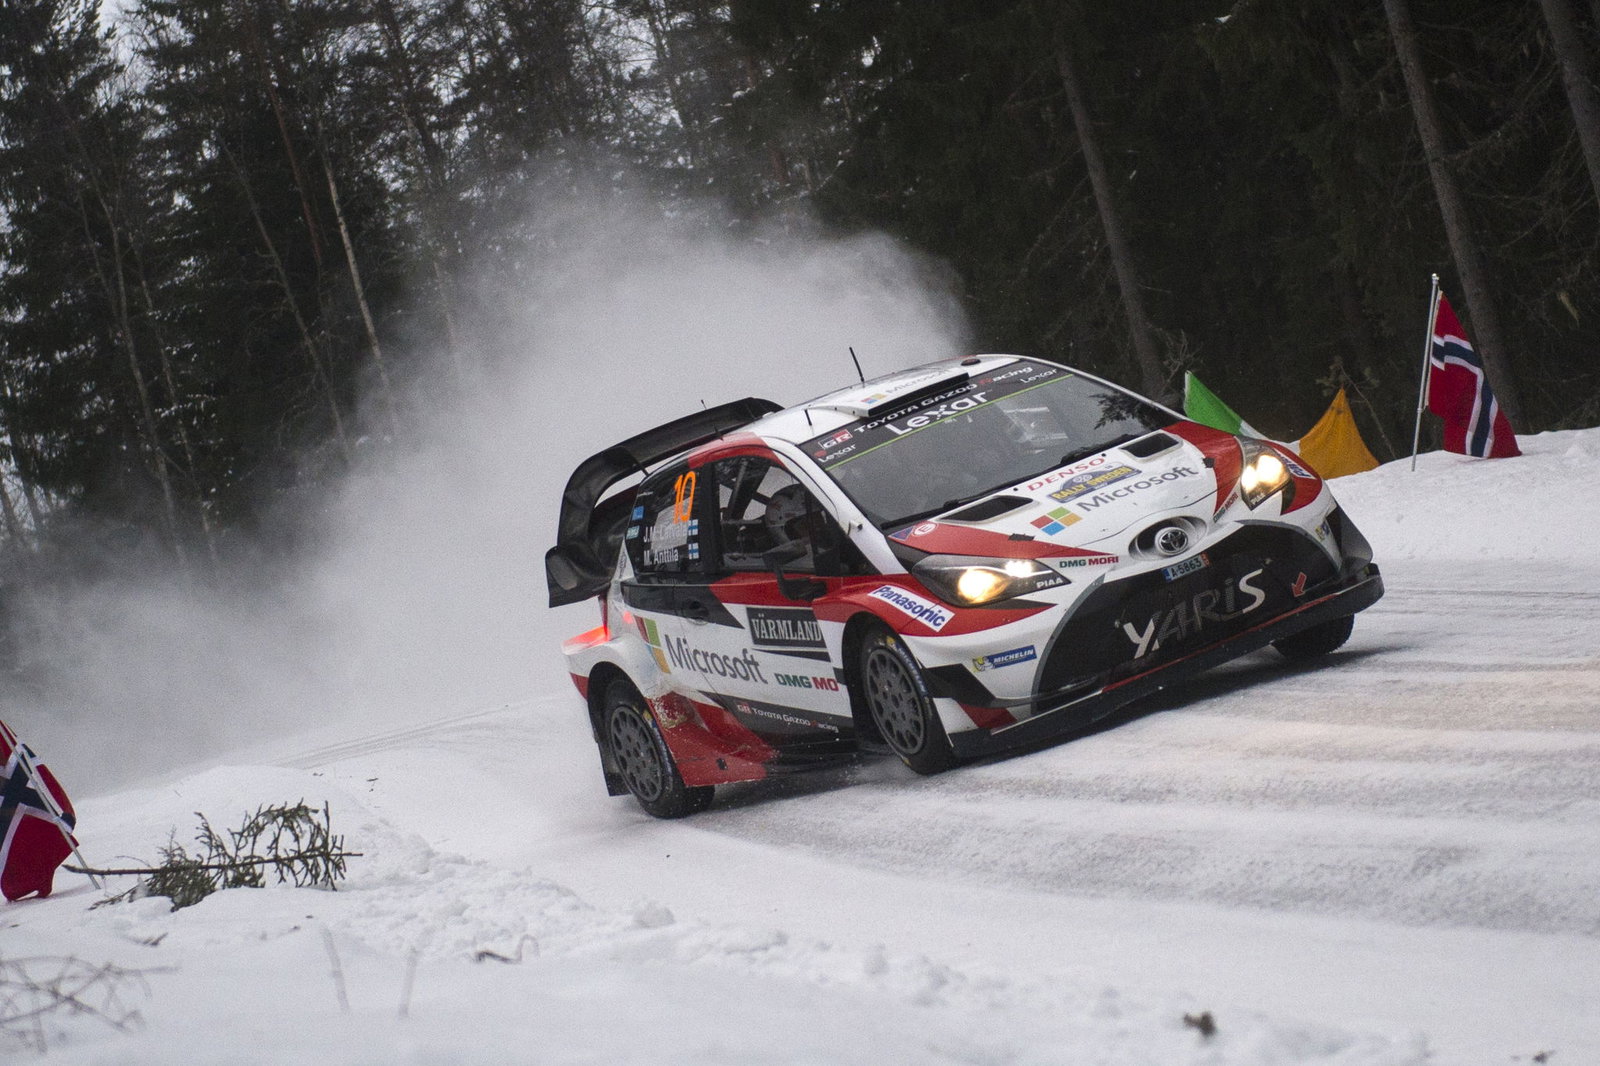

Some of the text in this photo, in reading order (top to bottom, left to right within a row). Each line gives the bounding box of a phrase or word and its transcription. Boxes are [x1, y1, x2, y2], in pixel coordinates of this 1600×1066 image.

[1020, 368, 1058, 385] Lexar
[853, 404, 919, 433] TOYOTA
[921, 383, 978, 407] GAZOO
[979, 365, 1034, 386] Racing
[885, 391, 990, 435] Lexar
[818, 443, 857, 463] Lexar
[1027, 456, 1106, 491] DENSO
[672, 470, 696, 525] 10
[1050, 483, 1087, 501] RALLY
[1076, 466, 1199, 512] Microsoft
[653, 548, 679, 565] Anttila
[1059, 555, 1120, 569] DMG MORI
[1036, 577, 1064, 590] PIAA
[872, 585, 947, 628] Panasonic
[751, 614, 824, 642] VÄRMLAND
[664, 634, 769, 685] Microsoft
[993, 648, 1034, 664] MICHELIN
[774, 672, 813, 689] DMG
[751, 707, 783, 721] TOYOTA
[782, 714, 812, 727] GAZOO
